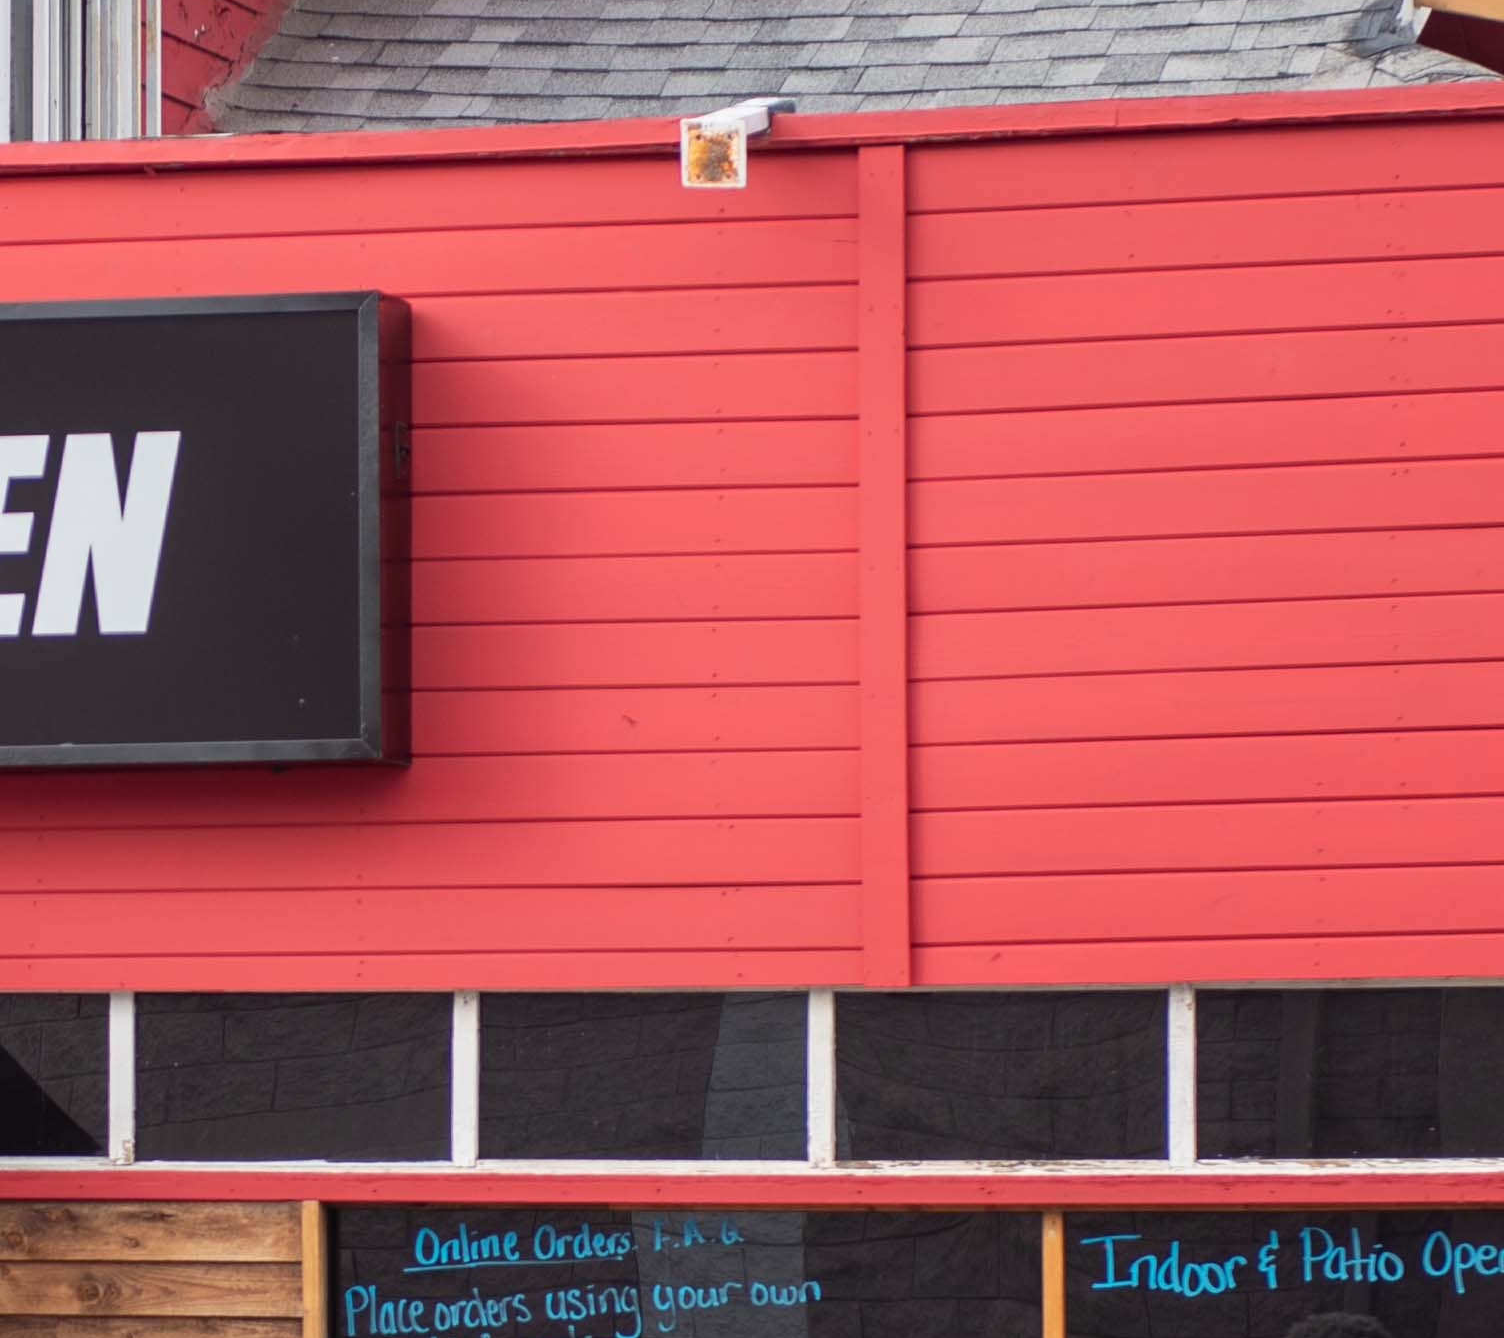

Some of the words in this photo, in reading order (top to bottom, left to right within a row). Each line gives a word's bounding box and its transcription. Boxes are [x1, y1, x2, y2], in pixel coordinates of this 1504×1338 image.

[416, 1222, 520, 1265] Online
[1080, 1233, 1248, 1297] Indoor
[1258, 1229, 1280, 1290] &
[1299, 1227, 1404, 1282] Patio
[344, 1284, 429, 1337] Place
[433, 1288, 533, 1331] orders
[652, 1281, 742, 1332] your
[750, 1280, 821, 1306] own
